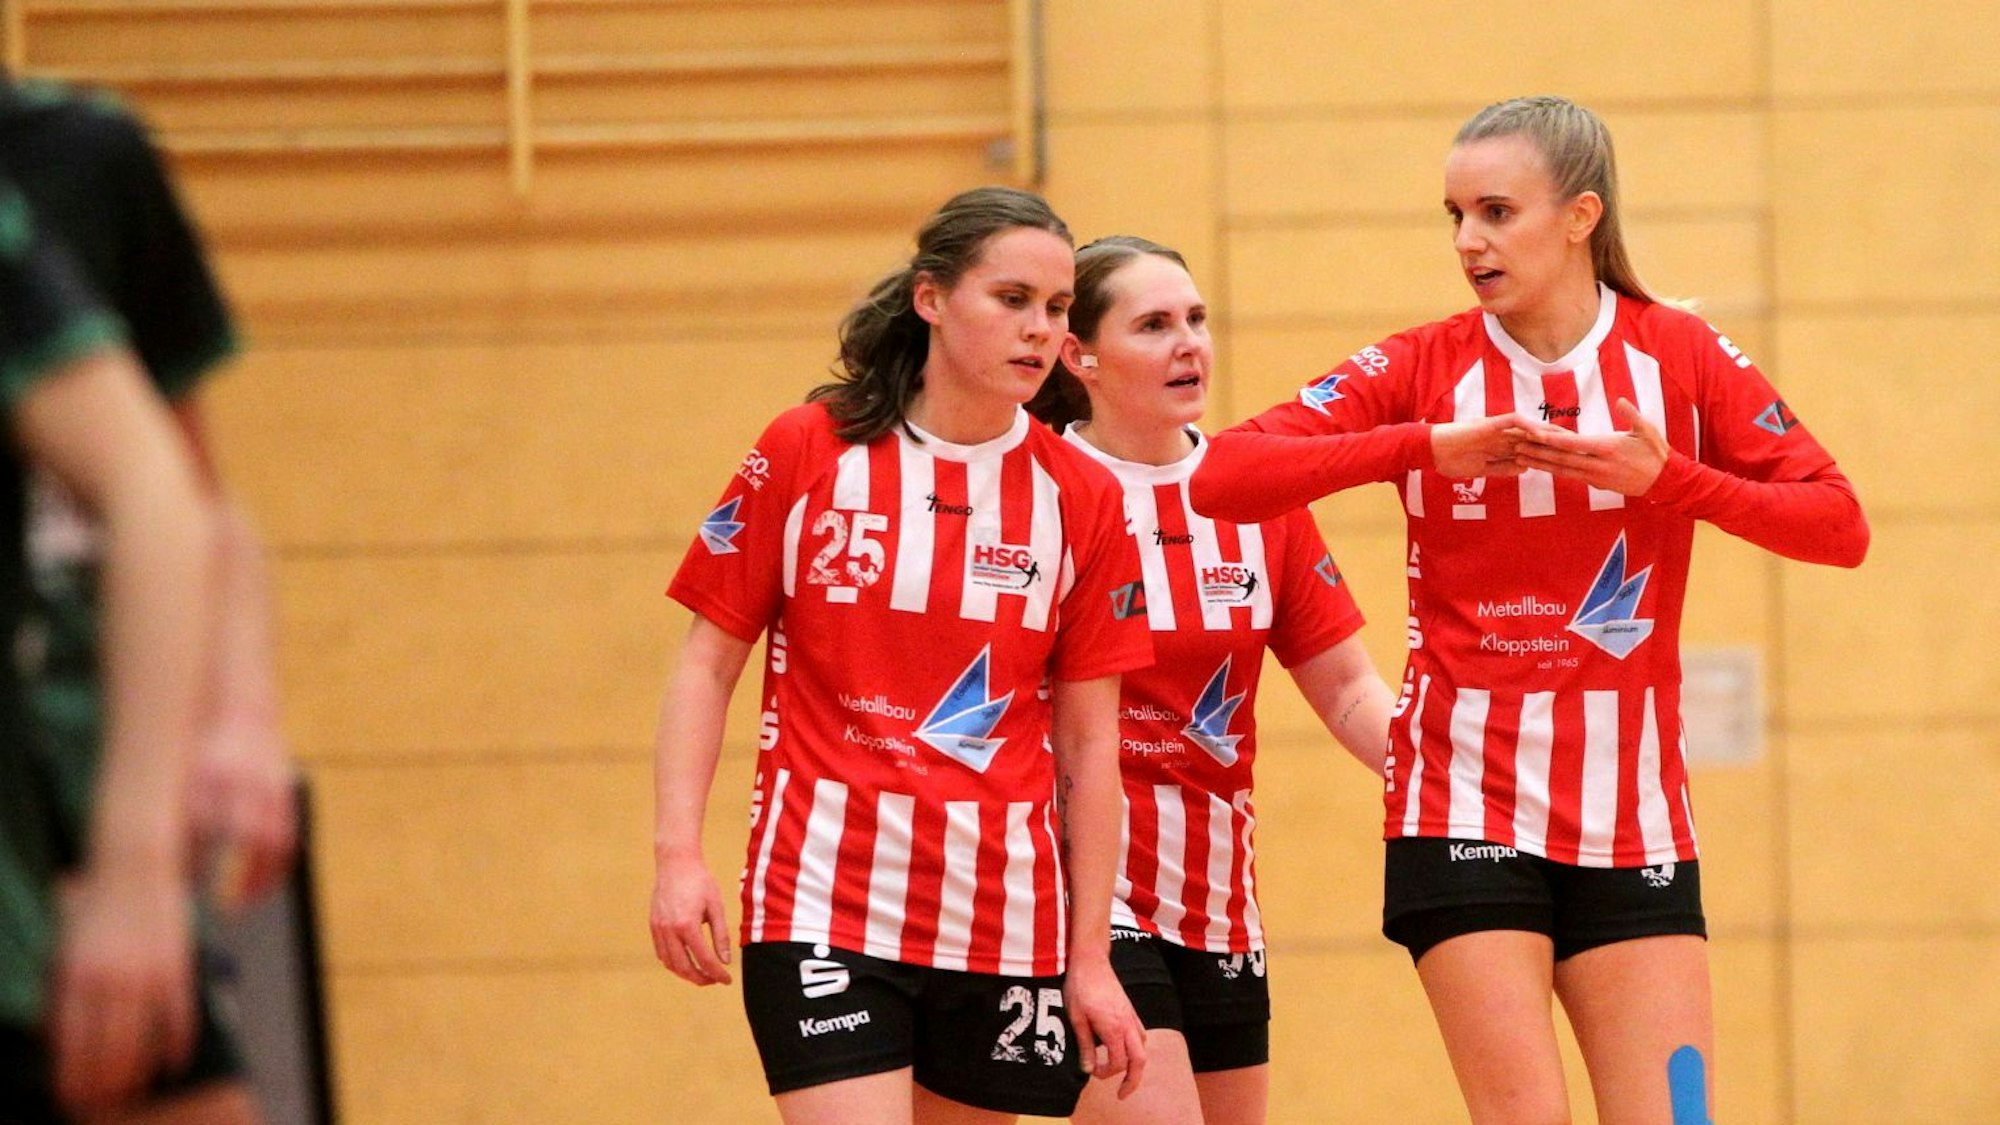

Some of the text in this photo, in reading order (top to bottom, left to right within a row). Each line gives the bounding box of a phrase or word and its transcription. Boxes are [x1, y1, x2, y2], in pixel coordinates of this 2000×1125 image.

[806, 509, 889, 588] 25
[974, 544, 1030, 569] HSG
[1202, 566, 1244, 584] HSG
[1477, 595, 1567, 618] Metallbau
[1479, 633, 1569, 657] Kloppstein
[1557, 657, 1579, 668] 1965
[1119, 704, 1180, 721] etallbau
[844, 724, 916, 757] Kloppstein
[1121, 737, 1185, 757] oppstein
[1449, 842, 1518, 863] Kempa
[798, 1009, 871, 1038] Kempa
[991, 985, 1066, 1066] 25
